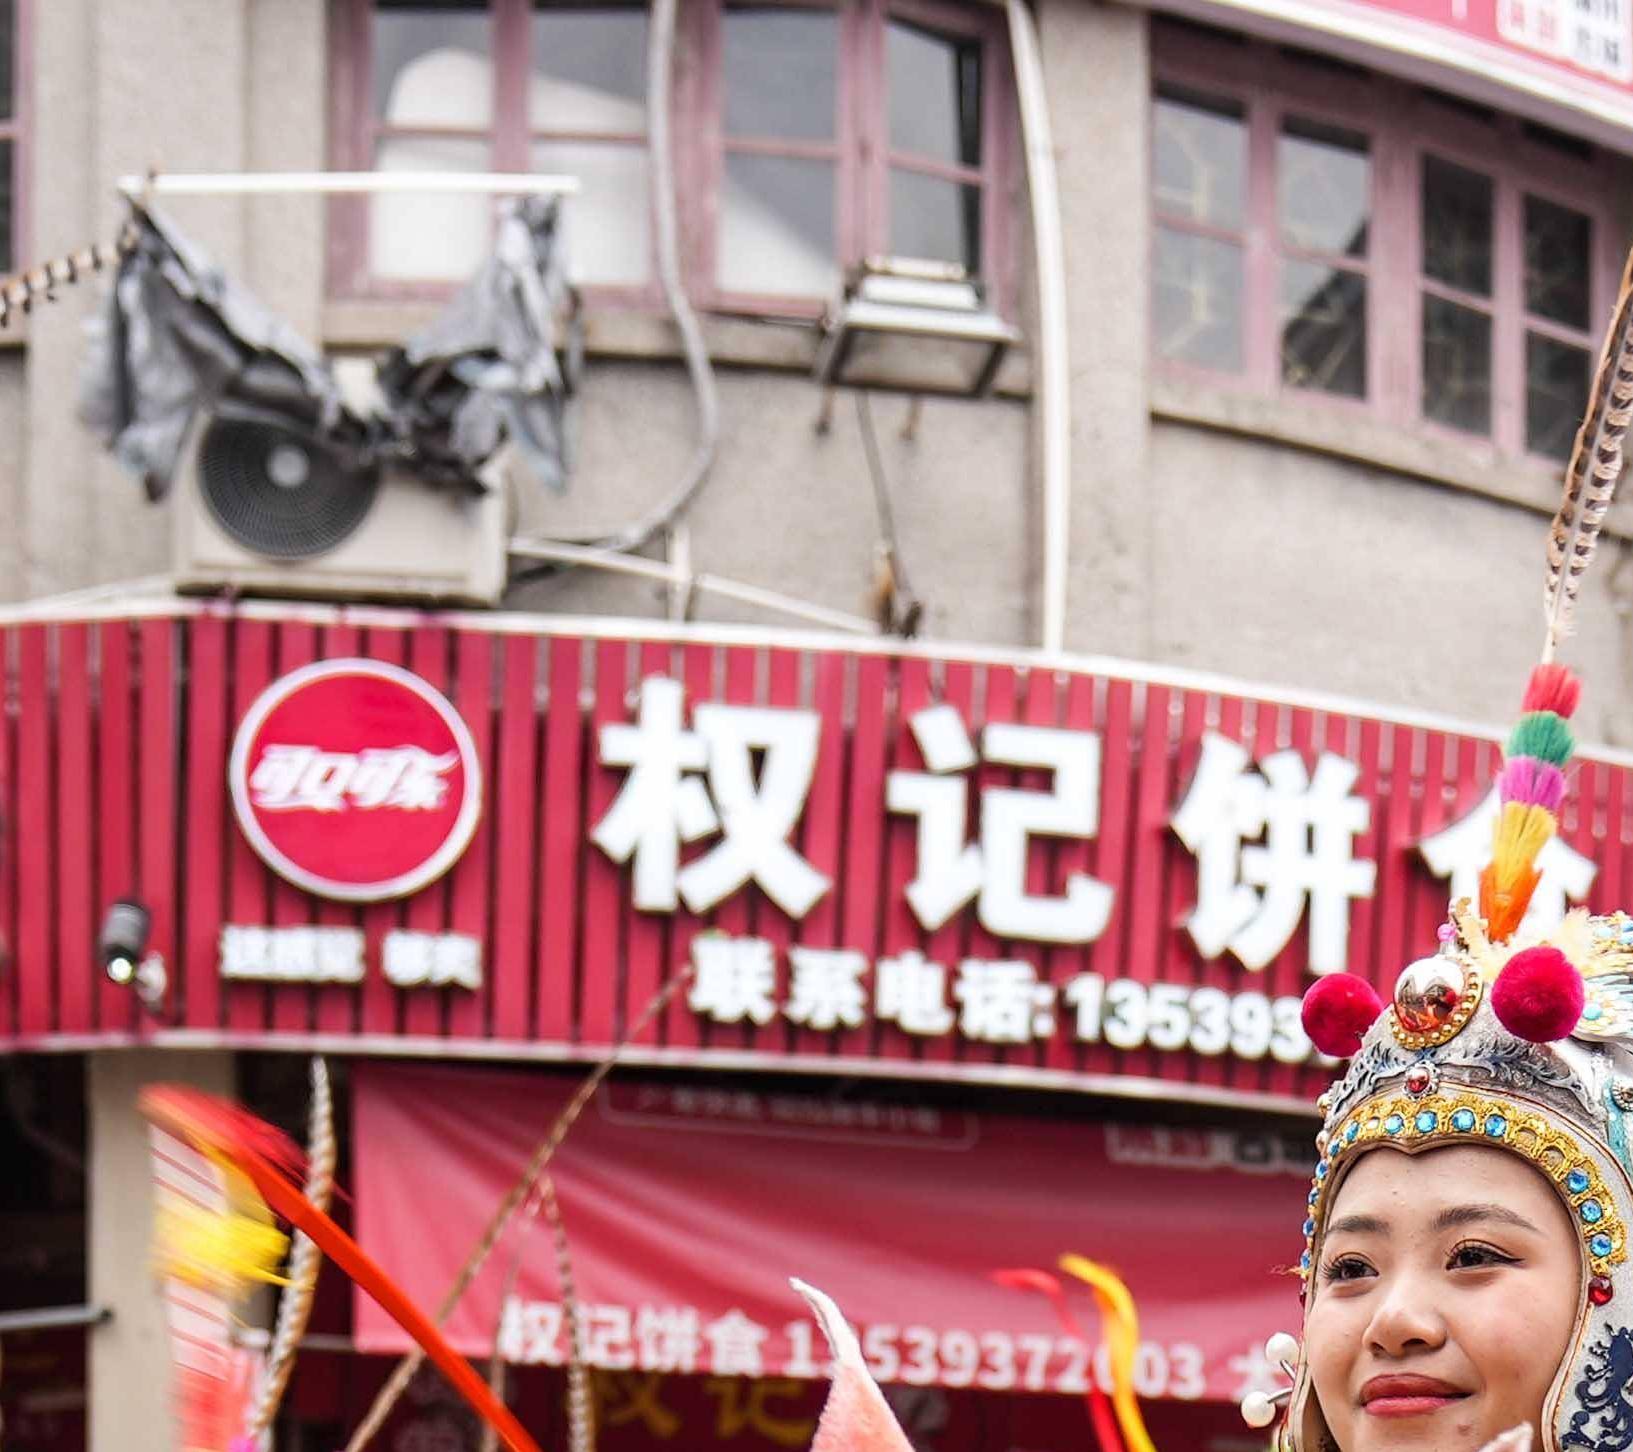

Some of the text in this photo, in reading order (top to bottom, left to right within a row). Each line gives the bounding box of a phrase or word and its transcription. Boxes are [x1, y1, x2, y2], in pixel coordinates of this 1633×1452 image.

[498, 1295, 765, 1379] 权记饼食
[782, 1319, 1208, 1400] 153937203
